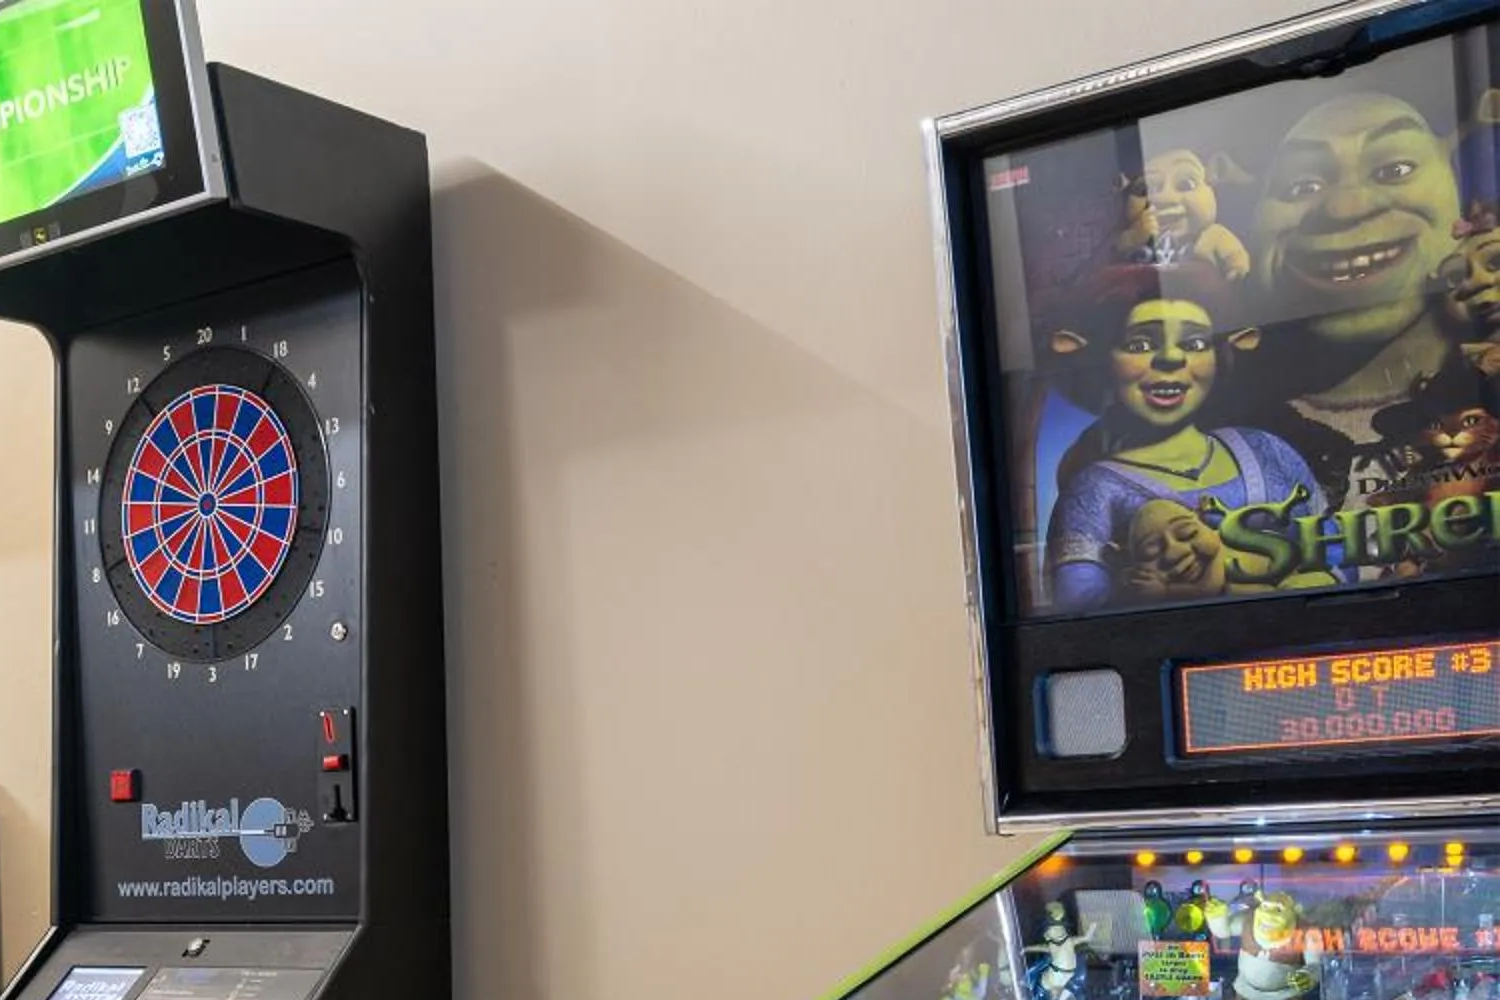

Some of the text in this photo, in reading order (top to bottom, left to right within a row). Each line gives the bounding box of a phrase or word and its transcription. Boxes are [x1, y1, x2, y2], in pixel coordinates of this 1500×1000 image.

[198, 328, 212, 343] 20
[241, 326, 247, 341] 1
[163, 346, 171, 362] 5
[273, 341, 288, 357] 18
[127, 378, 140, 394] 12
[308, 373, 317, 388] 4
[105, 420, 113, 435] 9
[325, 418, 340, 434] 13
[86, 468, 100, 484] 14
[337, 472, 346, 488] 6
[84, 520, 96, 535] 11
[328, 528, 342, 545] 10
[92, 568, 100, 584] 8
[310, 581, 324, 598] 15
[106, 610, 120, 626] 16
[284, 624, 292, 641] 2
[136, 643, 145, 659] 7
[244, 654, 259, 670] 17
[1243, 648, 1491, 691] HIGH SCORE #3
[167, 663, 181, 680] 19
[208, 667, 217, 683] 3
[141, 799, 239, 838] Radikal
[118, 875, 334, 900] www.radikalplayers.com
